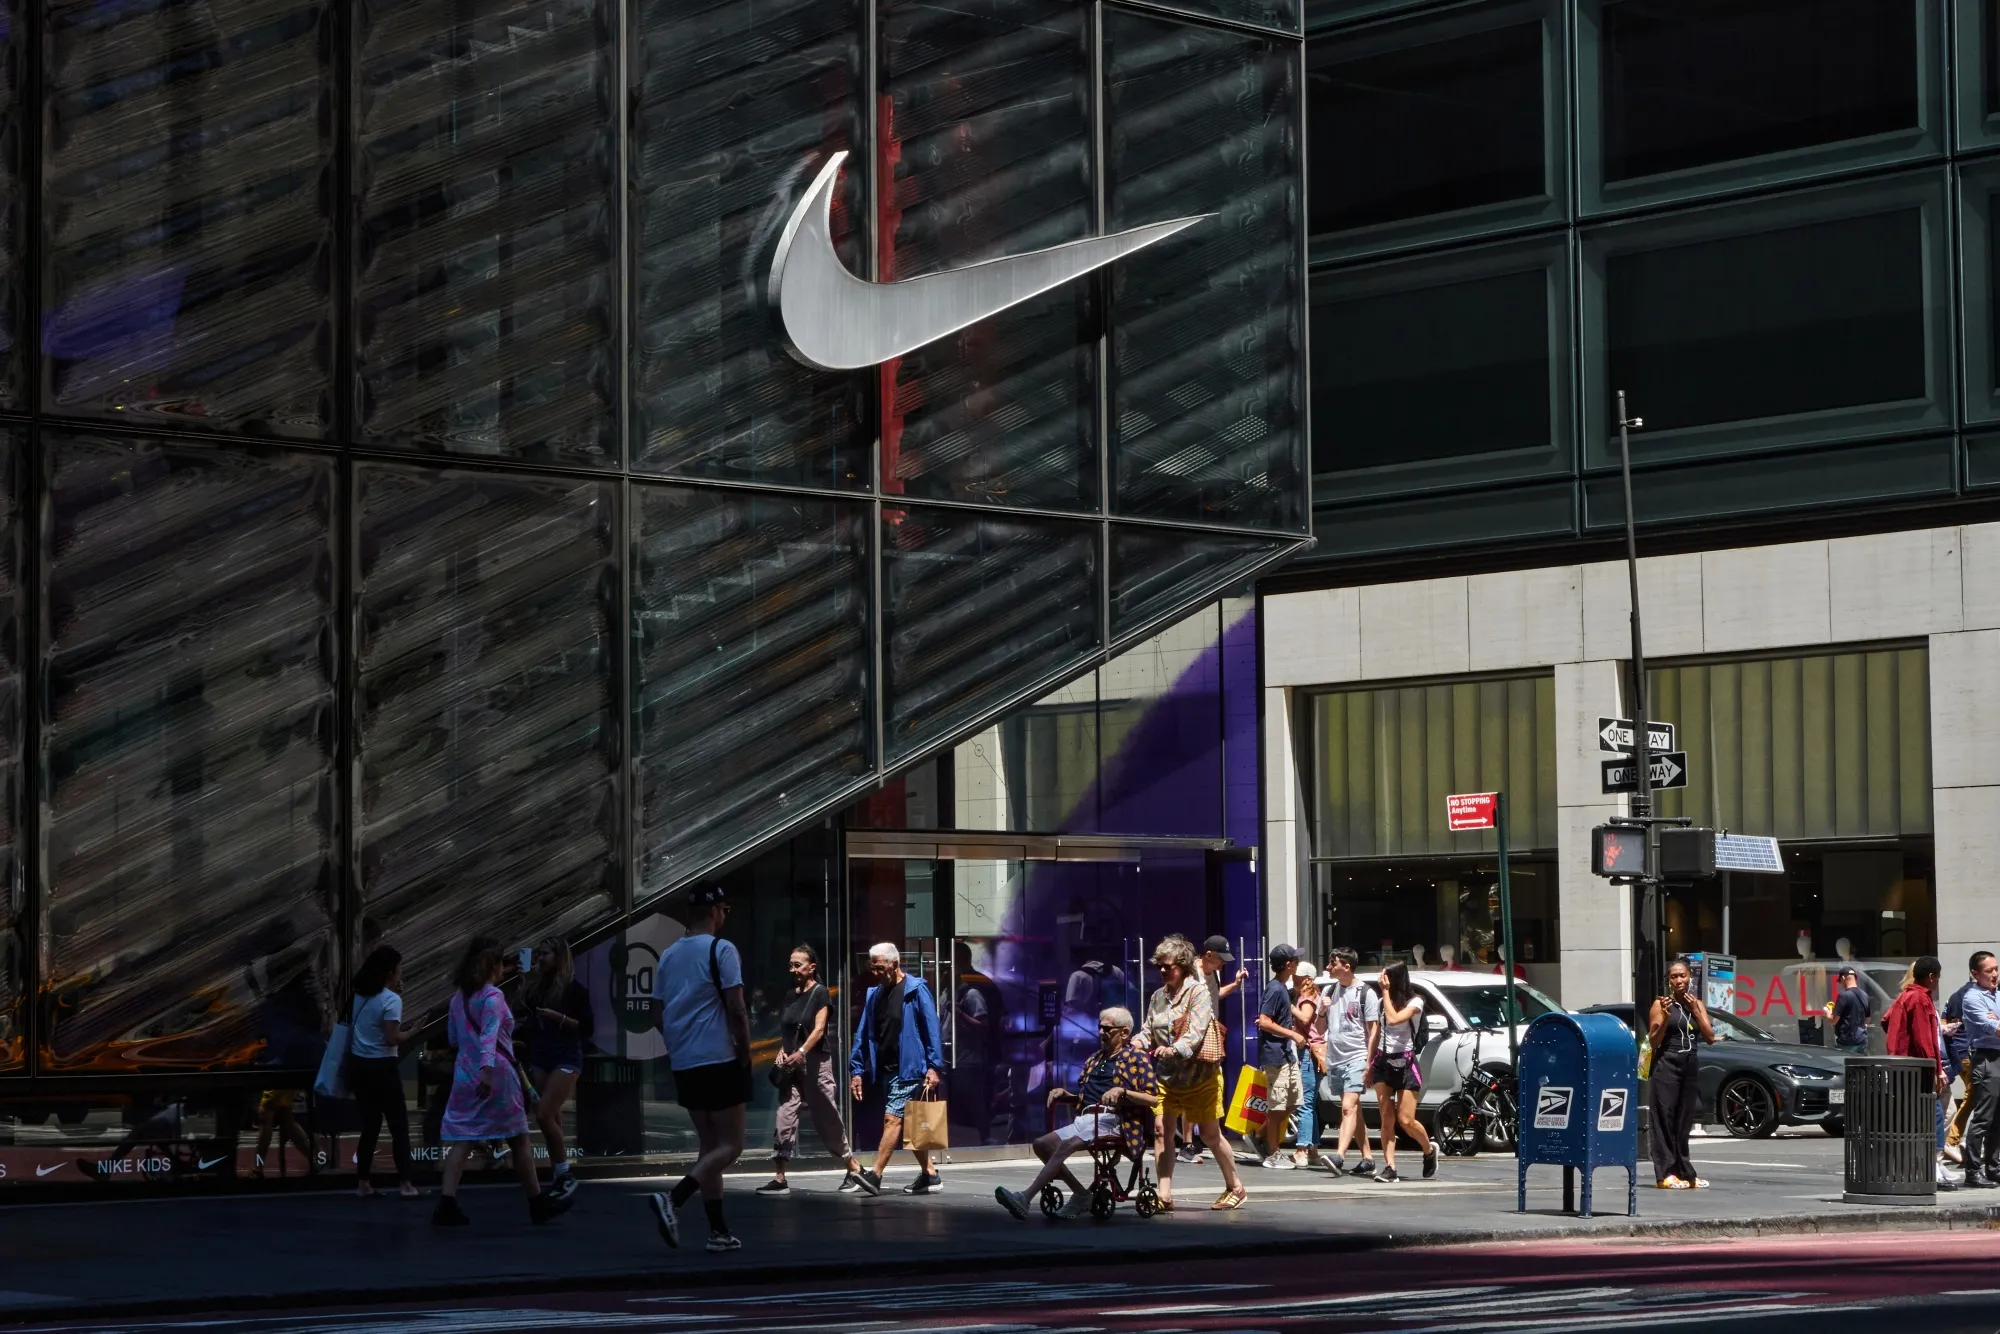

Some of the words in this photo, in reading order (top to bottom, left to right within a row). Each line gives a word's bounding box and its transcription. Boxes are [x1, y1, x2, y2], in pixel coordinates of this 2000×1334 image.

[1608, 729, 1629, 743] ONE
[1648, 733, 1666, 747] AY
[1614, 769, 1637, 783] ONE
[1650, 764, 1674, 779] WAY
[1450, 799, 1460, 807] NO
[1461, 797, 1490, 806] STOPPING
[1451, 806, 1477, 815] Anytime
[1736, 975, 1841, 1017] SAL
[1246, 1096, 1269, 1113] LEG
[533, 1147, 550, 1160] NIK
[97, 1159, 132, 1174] NIKE
[136, 1157, 172, 1173] KIDS
